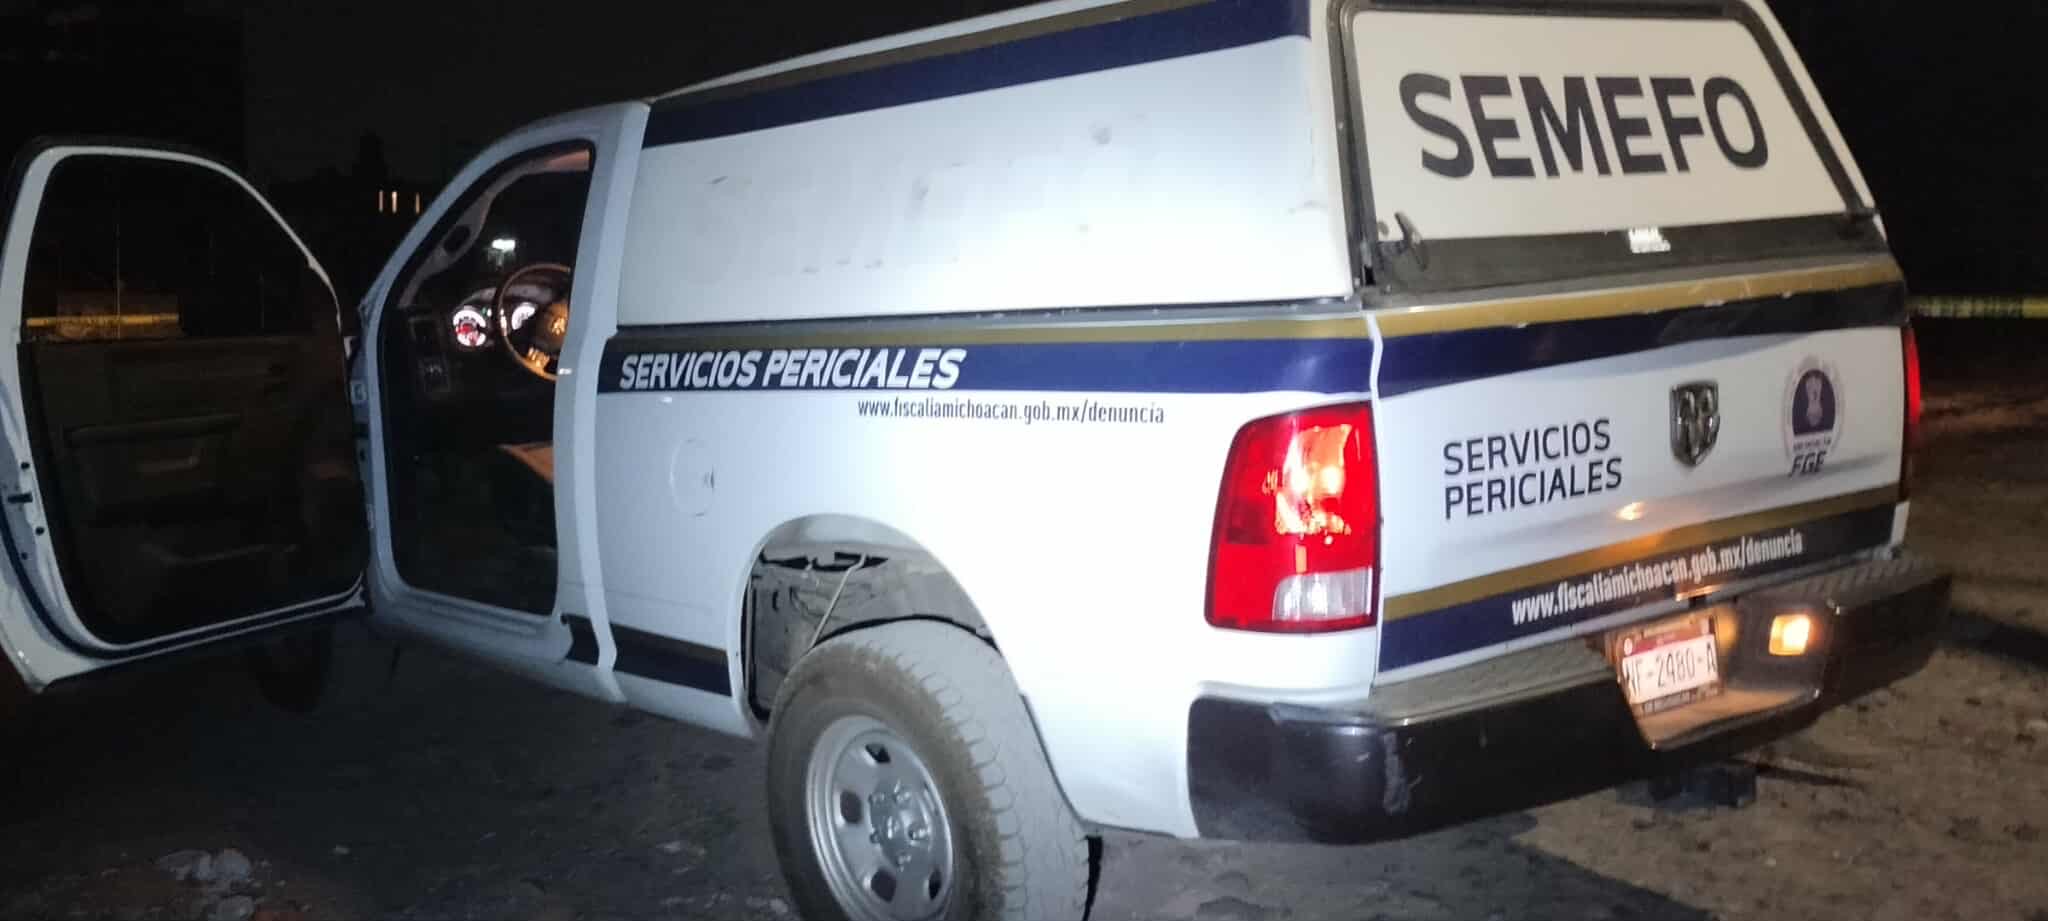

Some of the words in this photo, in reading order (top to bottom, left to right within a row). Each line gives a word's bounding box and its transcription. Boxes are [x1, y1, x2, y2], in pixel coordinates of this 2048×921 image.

[1398, 73, 1768, 179] SEMEFO
[619, 351, 760, 389] SERVICIOS
[760, 348, 967, 389] PERICIALES
[857, 398, 1165, 425] www.fiscaliamichoacan.gob.mx/denuncia
[1443, 417, 1611, 477] SERVICIOS
[1445, 457, 1622, 520] PERICIALES
[1511, 530, 1803, 625] www.fiscaliamichoacan.gob.mx/denuncia
